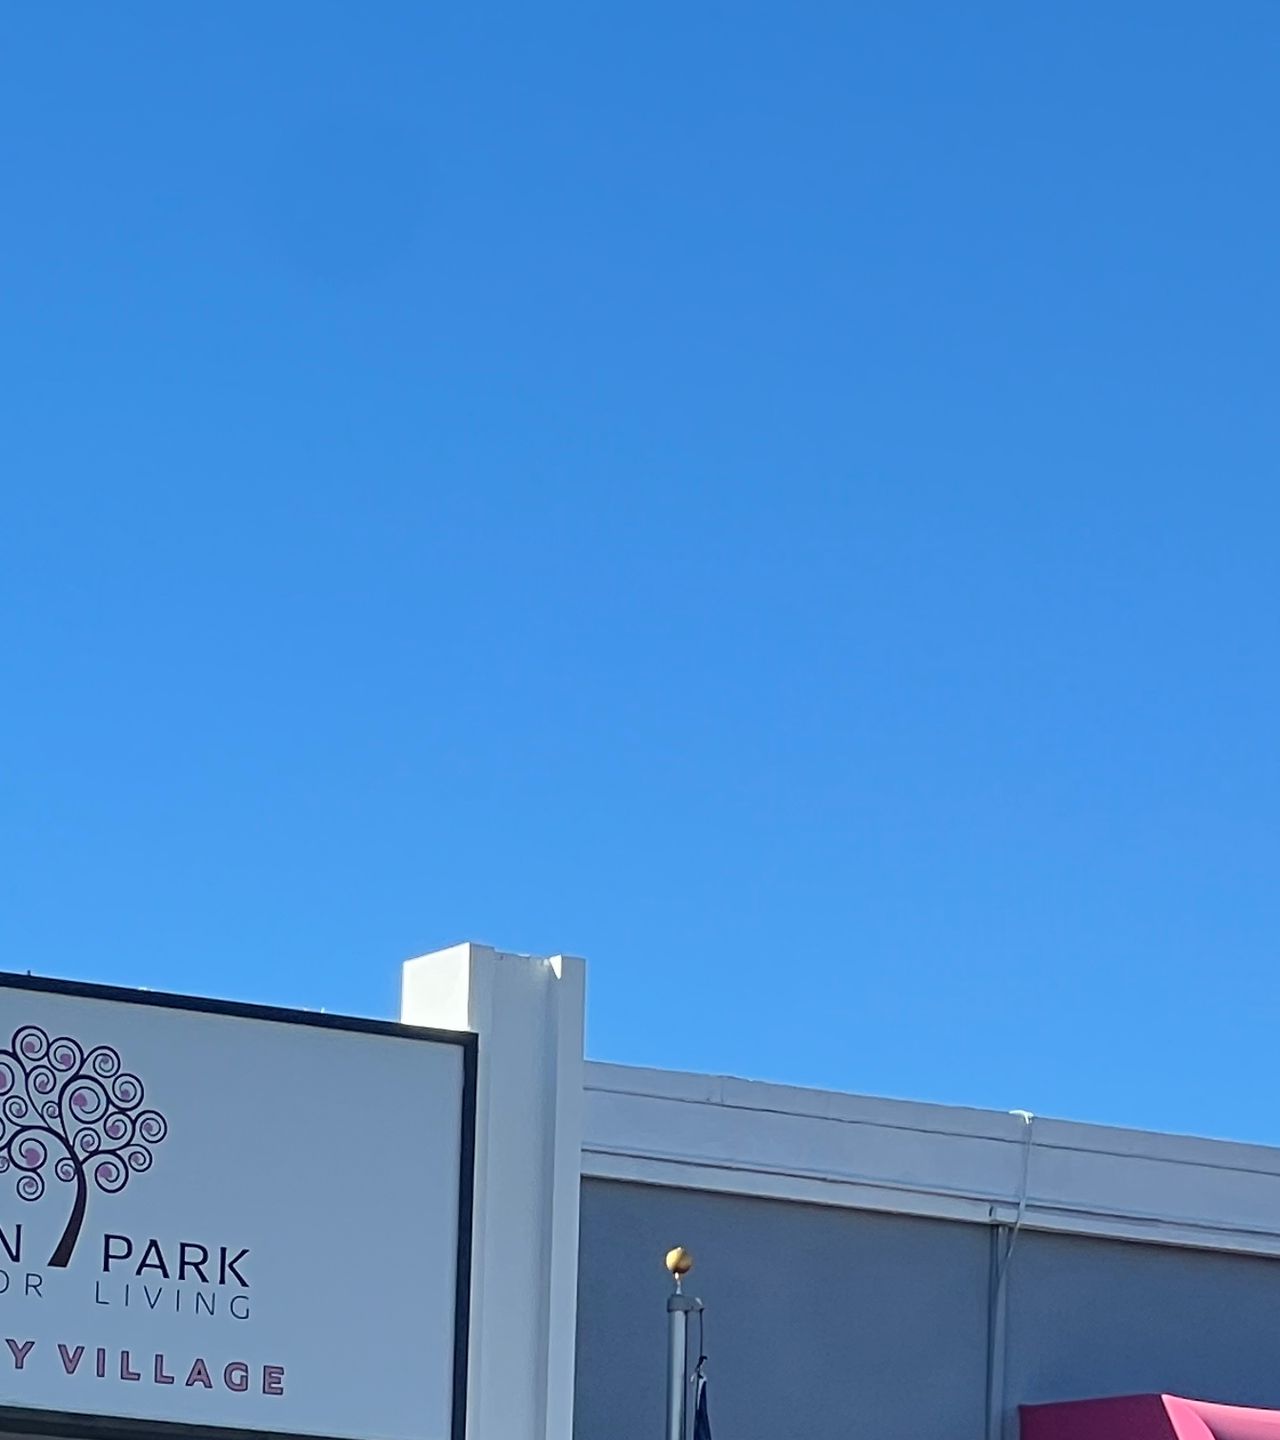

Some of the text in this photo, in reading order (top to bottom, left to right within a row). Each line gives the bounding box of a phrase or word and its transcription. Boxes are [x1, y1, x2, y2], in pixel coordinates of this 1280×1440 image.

[102, 1233, 250, 1288] PARK
[94, 1280, 250, 1320] LIVING
[57, 1343, 285, 1396] VILLAGE
